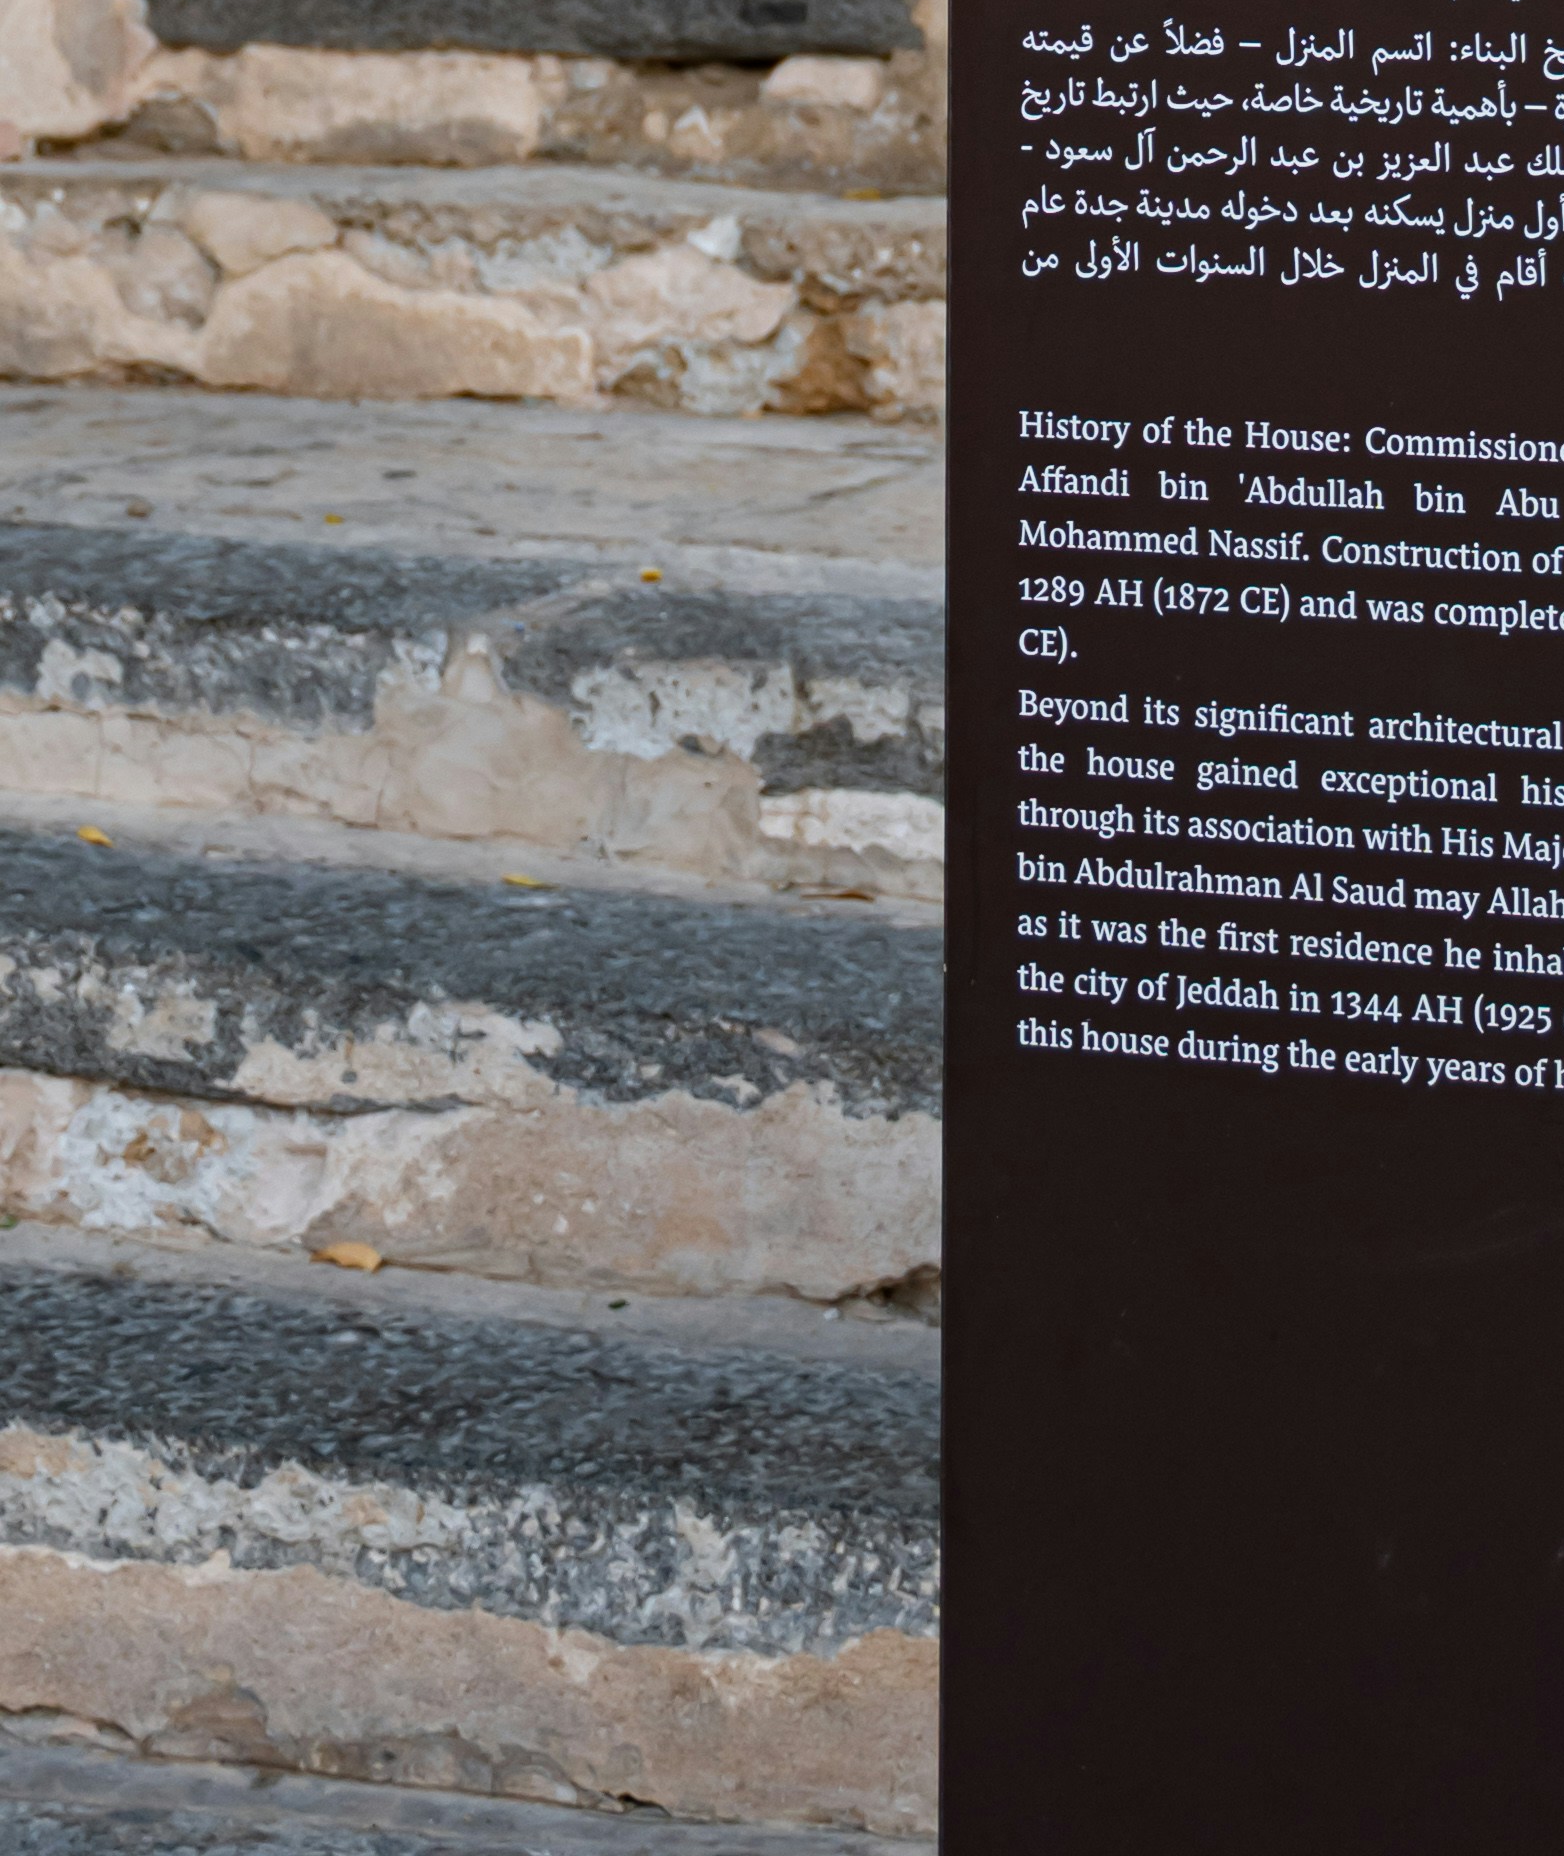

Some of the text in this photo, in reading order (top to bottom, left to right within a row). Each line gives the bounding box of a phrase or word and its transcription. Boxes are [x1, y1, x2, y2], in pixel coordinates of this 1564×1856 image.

[1021, 23, 1094, 61] قيمته
[1110, 32, 1150, 64] عن
[1275, 26, 1354, 68] المنزل
[1371, 30, 1432, 76] اتسم
[1450, 31, 1527, 72] البناء:
[1020, 75, 1086, 122] تاريخ
[1091, 75, 1158, 119] ارتبط
[1166, 83, 1234, 118] حيث
[1241, 81, 1324, 114] خاصة،
[1329, 84, 1424, 126] تاريخية
[1430, 78, 1517, 127] بأهمية
[1045, 138, 1113, 171] سعود
[1124, 125, 1157, 172] آل
[1166, 134, 1257, 177] الرحمن
[1270, 144, 1320, 177] عبد
[1332, 150, 1365, 179] بن
[1375, 140, 1451, 183] العزيز
[1464, 150, 1515, 182] عبد
[1021, 183, 1066, 230] عام
[1074, 188, 1129, 224] جدة
[1135, 187, 1211, 227] مدينة
[1220, 188, 1298, 231] دخوله
[1309, 200, 1354, 234] بعد
[1364, 192, 1446, 237] يسكنه
[1453, 196, 1515, 239] منزل
[1018, 409, 1132, 451] History
[1142, 414, 1176, 445] of
[1183, 416, 1232, 449] the
[1244, 419, 1351, 454] House:
[1017, 464, 1131, 498] Affandi
[1157, 469, 1210, 503] bin
[1413, 481, 1467, 515] bin
[1495, 487, 1561, 520] Abu
[1018, 518, 1199, 557] Mohammed
[1207, 528, 1310, 562] Nassif.
[1321, 534, 1523, 574] Construction
[1018, 688, 1130, 727] Beyond
[1143, 695, 1180, 727] its
[1194, 699, 1355, 738] significant
[1368, 711, 1564, 752] architectural
[1017, 741, 1065, 775] the
[1086, 745, 1175, 782] house
[1196, 756, 1299, 792] gained
[1320, 768, 1499, 805] exceptional
[1016, 796, 1136, 841] through
[1143, 805, 1180, 838] its
[1187, 813, 1356, 850] association
[1361, 821, 1434, 855] with
[1440, 826, 1494, 859] His
[1016, 850, 1068, 885] bin
[1073, 856, 1283, 900] Abdulrahman
[1288, 871, 1324, 903] Al
[1331, 875, 1407, 909] Saud
[1413, 887, 1481, 921] may
[1017, 913, 1048, 938] as
[1058, 910, 1082, 941] it
[1090, 919, 1148, 946] was
[1157, 917, 1207, 950] the
[1216, 920, 1280, 955] first
[1289, 930, 1433, 967] residence
[1443, 936, 1482, 971] he
[1016, 1016, 1073, 1050] this
[1080, 1020, 1170, 1058] house
[1177, 1029, 1280, 1075] during
[1286, 1038, 1337, 1072] the
[1344, 1045, 1420, 1086] early
[1426, 1056, 1506, 1088] years
[1514, 1057, 1549, 1088] of
